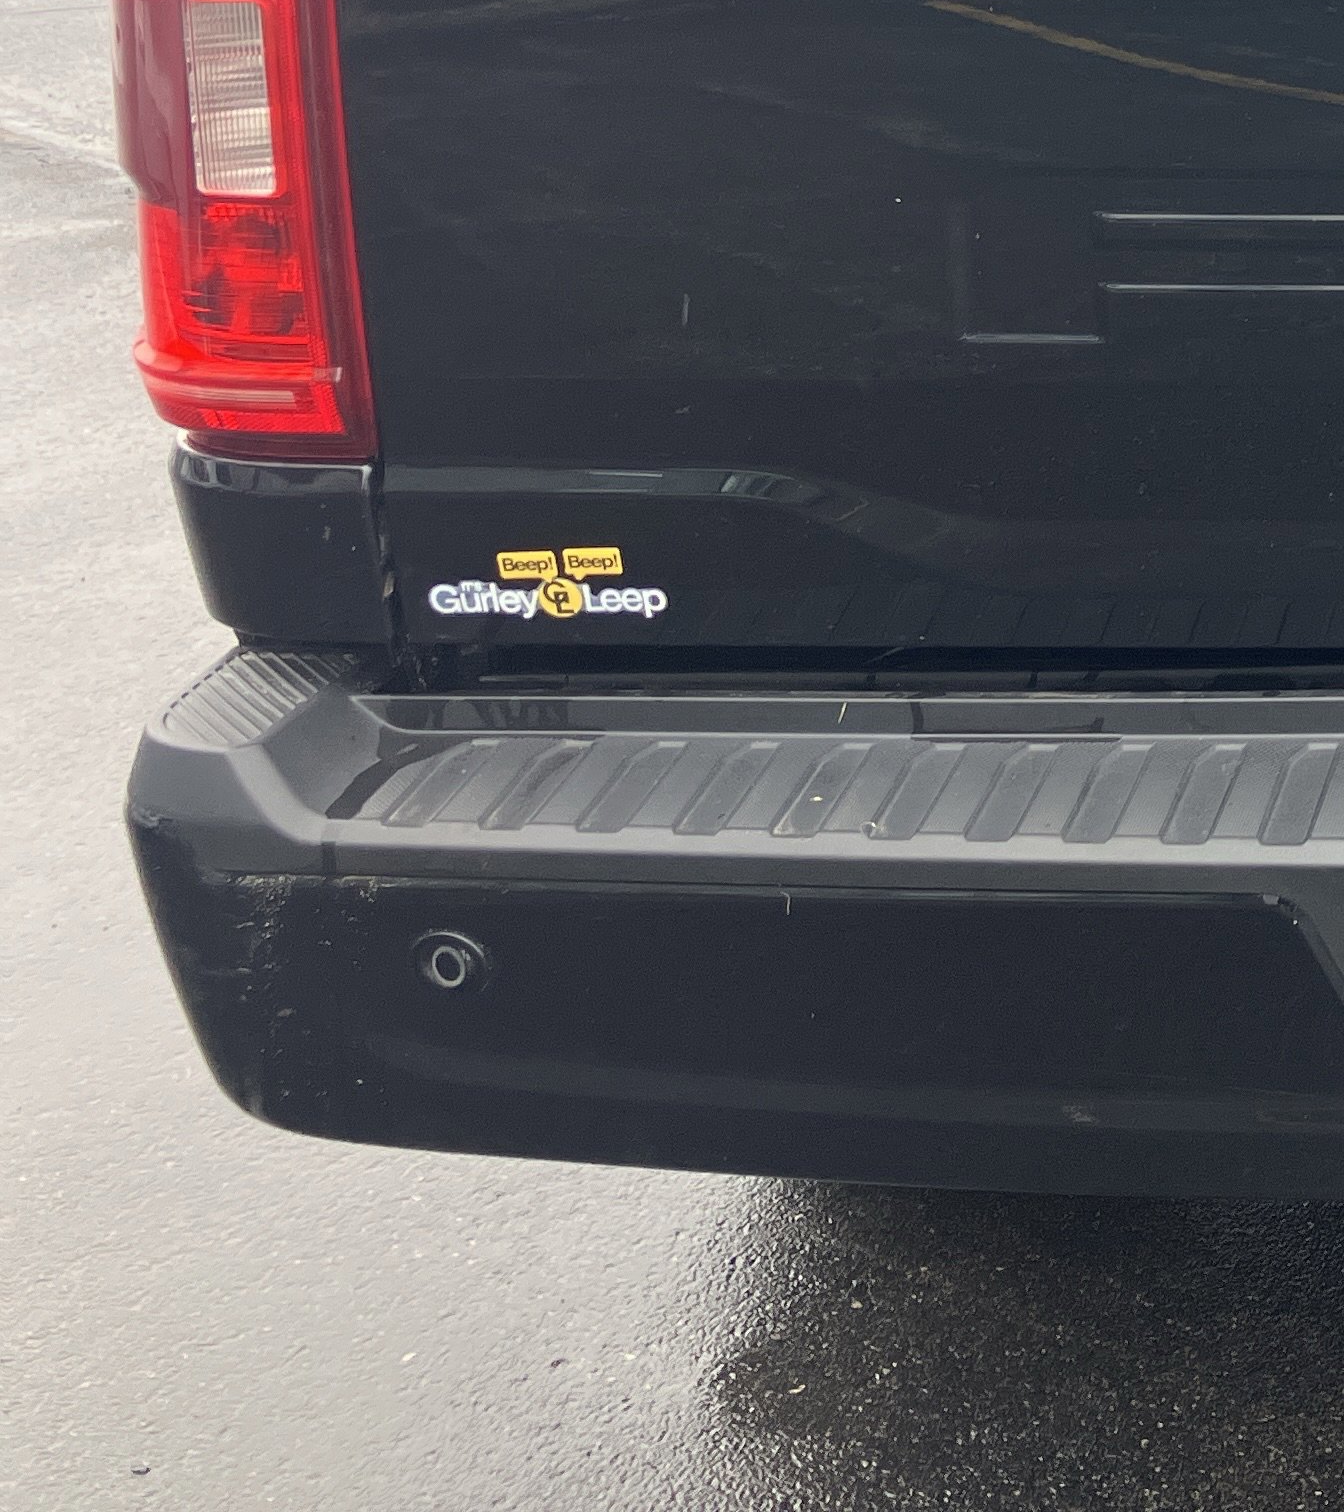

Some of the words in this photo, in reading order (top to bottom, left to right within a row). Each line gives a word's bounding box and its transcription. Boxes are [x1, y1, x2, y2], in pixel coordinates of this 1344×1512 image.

[501, 556, 554, 573] Beep!
[567, 553, 619, 570] Beep!
[429, 583, 540, 618] Gurley
[583, 582, 669, 618] Leep
